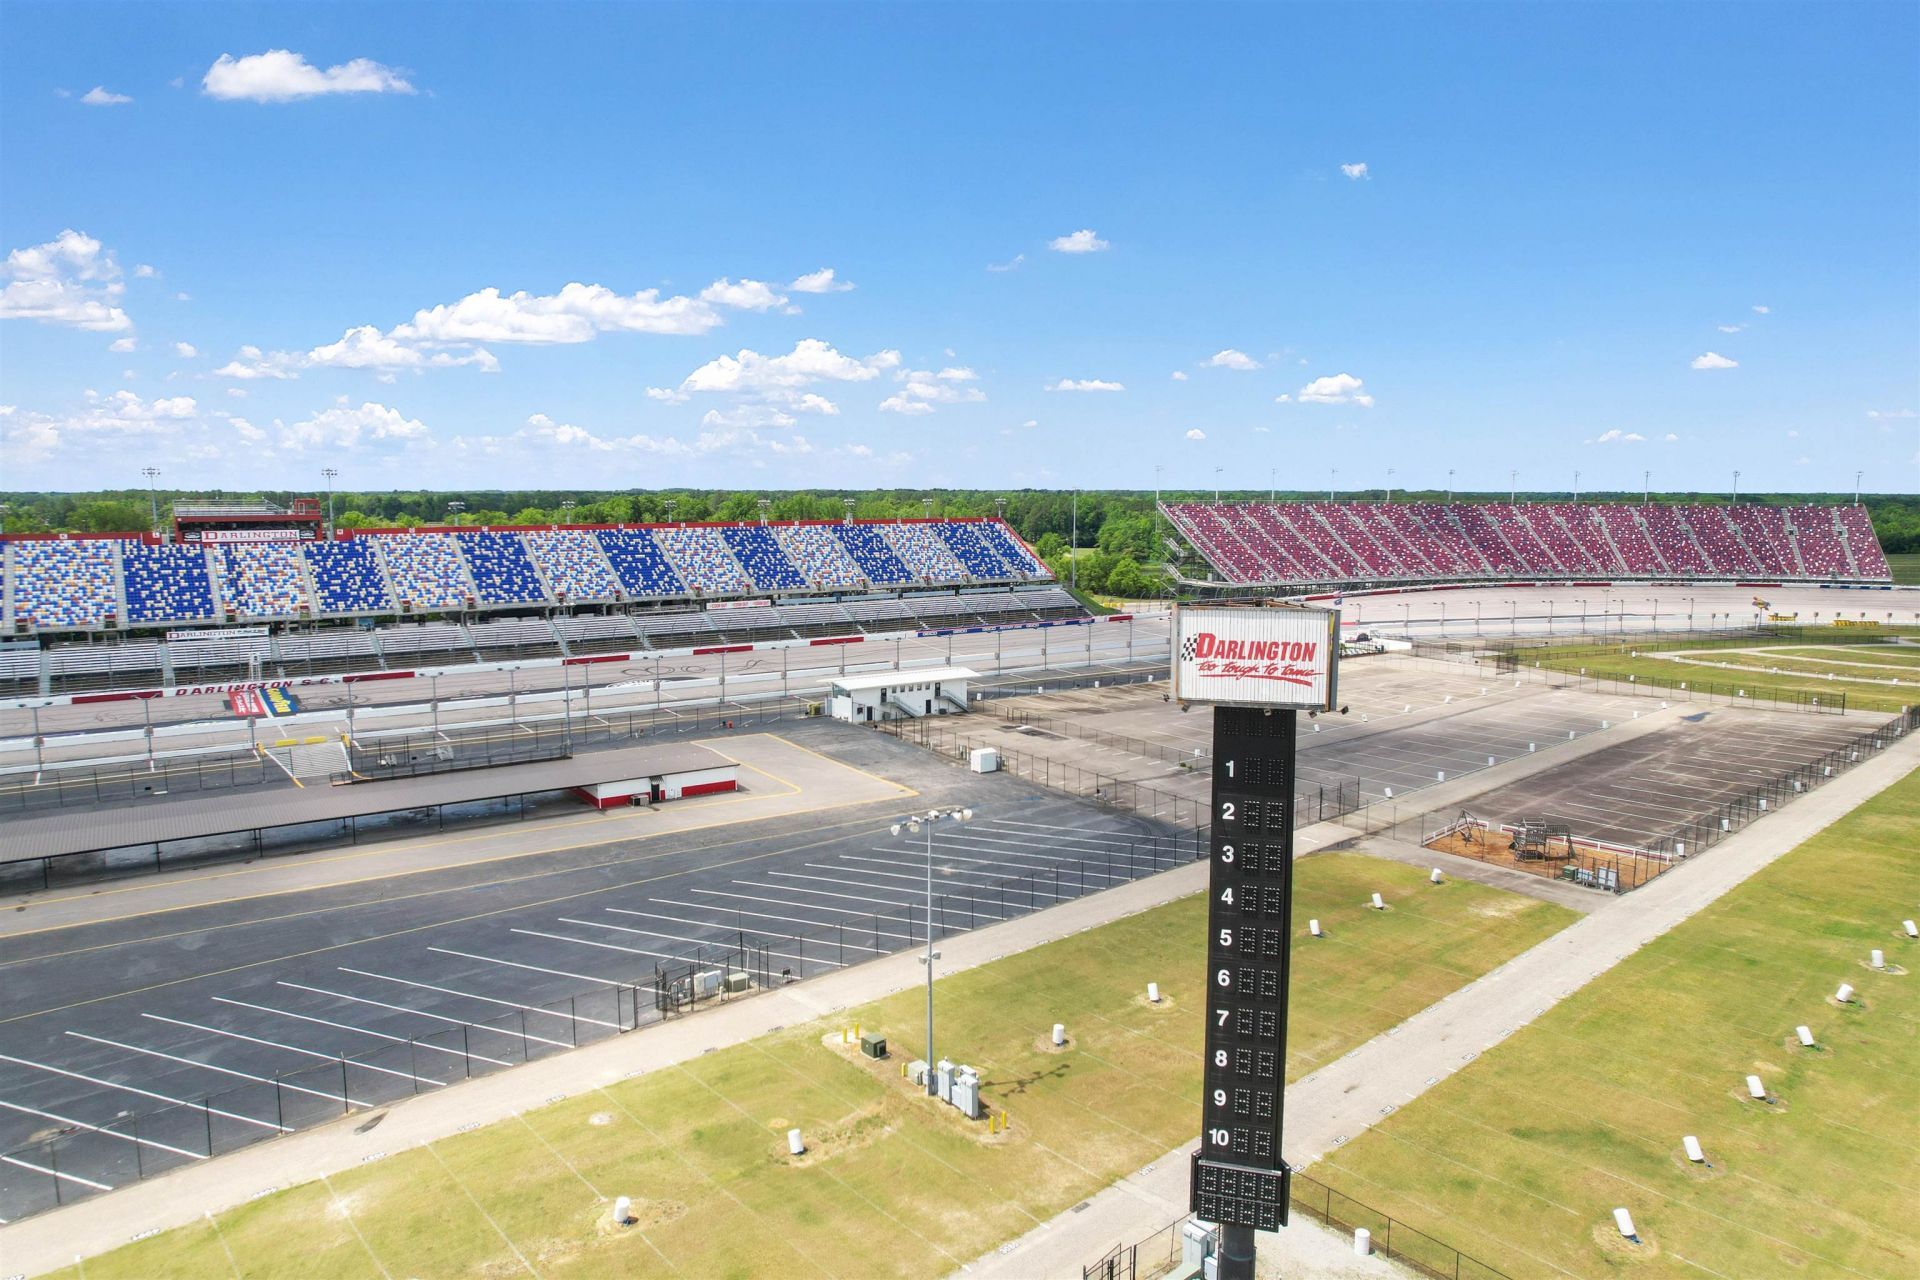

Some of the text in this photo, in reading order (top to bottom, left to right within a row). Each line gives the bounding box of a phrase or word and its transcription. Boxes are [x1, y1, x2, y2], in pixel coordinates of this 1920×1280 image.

[204, 531, 298, 540] DARLINGTON
[169, 629, 236, 638] DARLINGTON
[1195, 632, 1317, 662] DARLINGTON
[1195, 661, 1325, 681] too tough to tame
[175, 680, 293, 696] DARLINGTON
[1225, 760, 1235, 778] 1
[1222, 803, 1235, 820] 2
[1222, 845, 1234, 863] 3
[1221, 888, 1234, 905] 4
[1219, 929, 1232, 946] 5
[1217, 969, 1231, 986] 6
[1216, 1010, 1229, 1027] 7
[1214, 1049, 1228, 1067] 8
[1213, 1089, 1226, 1106] 9
[1209, 1128, 1229, 1146] 10
